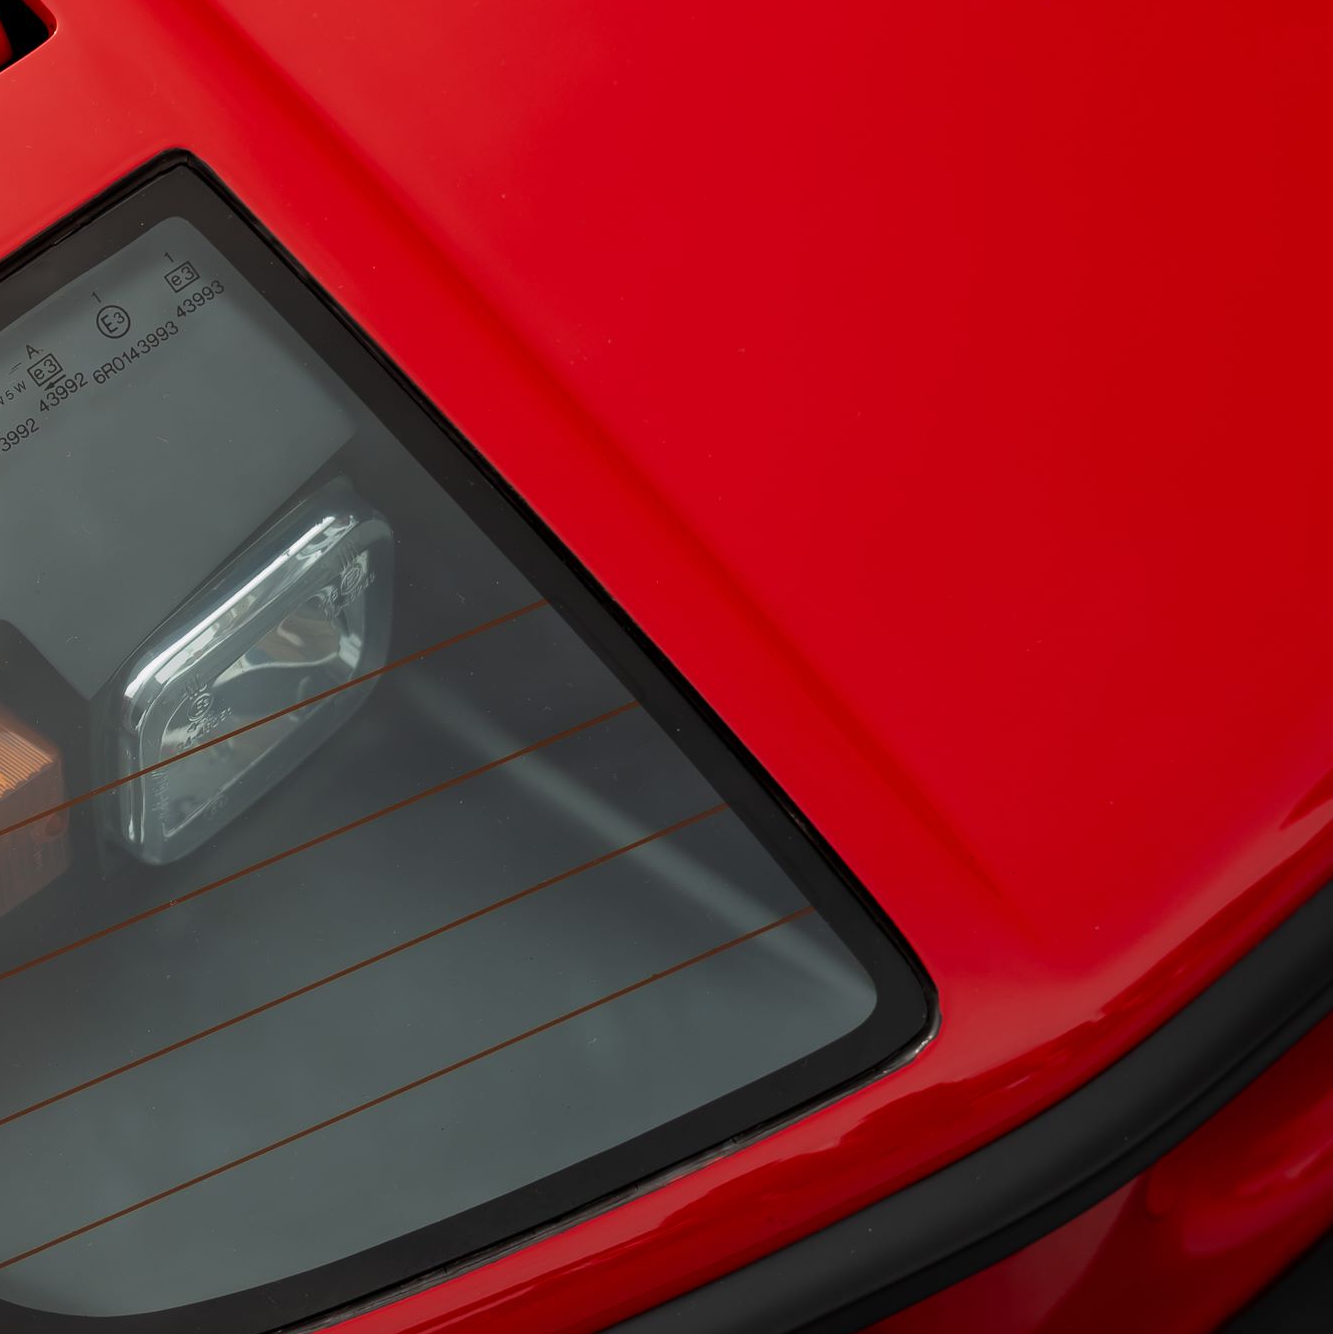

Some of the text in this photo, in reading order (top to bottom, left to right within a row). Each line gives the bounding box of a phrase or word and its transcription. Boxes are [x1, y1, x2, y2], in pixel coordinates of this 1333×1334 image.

[163, 252, 174, 263] 1
[91, 291, 102, 303] 1
[176, 280, 224, 318] 43993
[26, 344, 40, 359] A
[92, 321, 179, 384] 6R0143993
[38, 372, 88, 412] 43992
